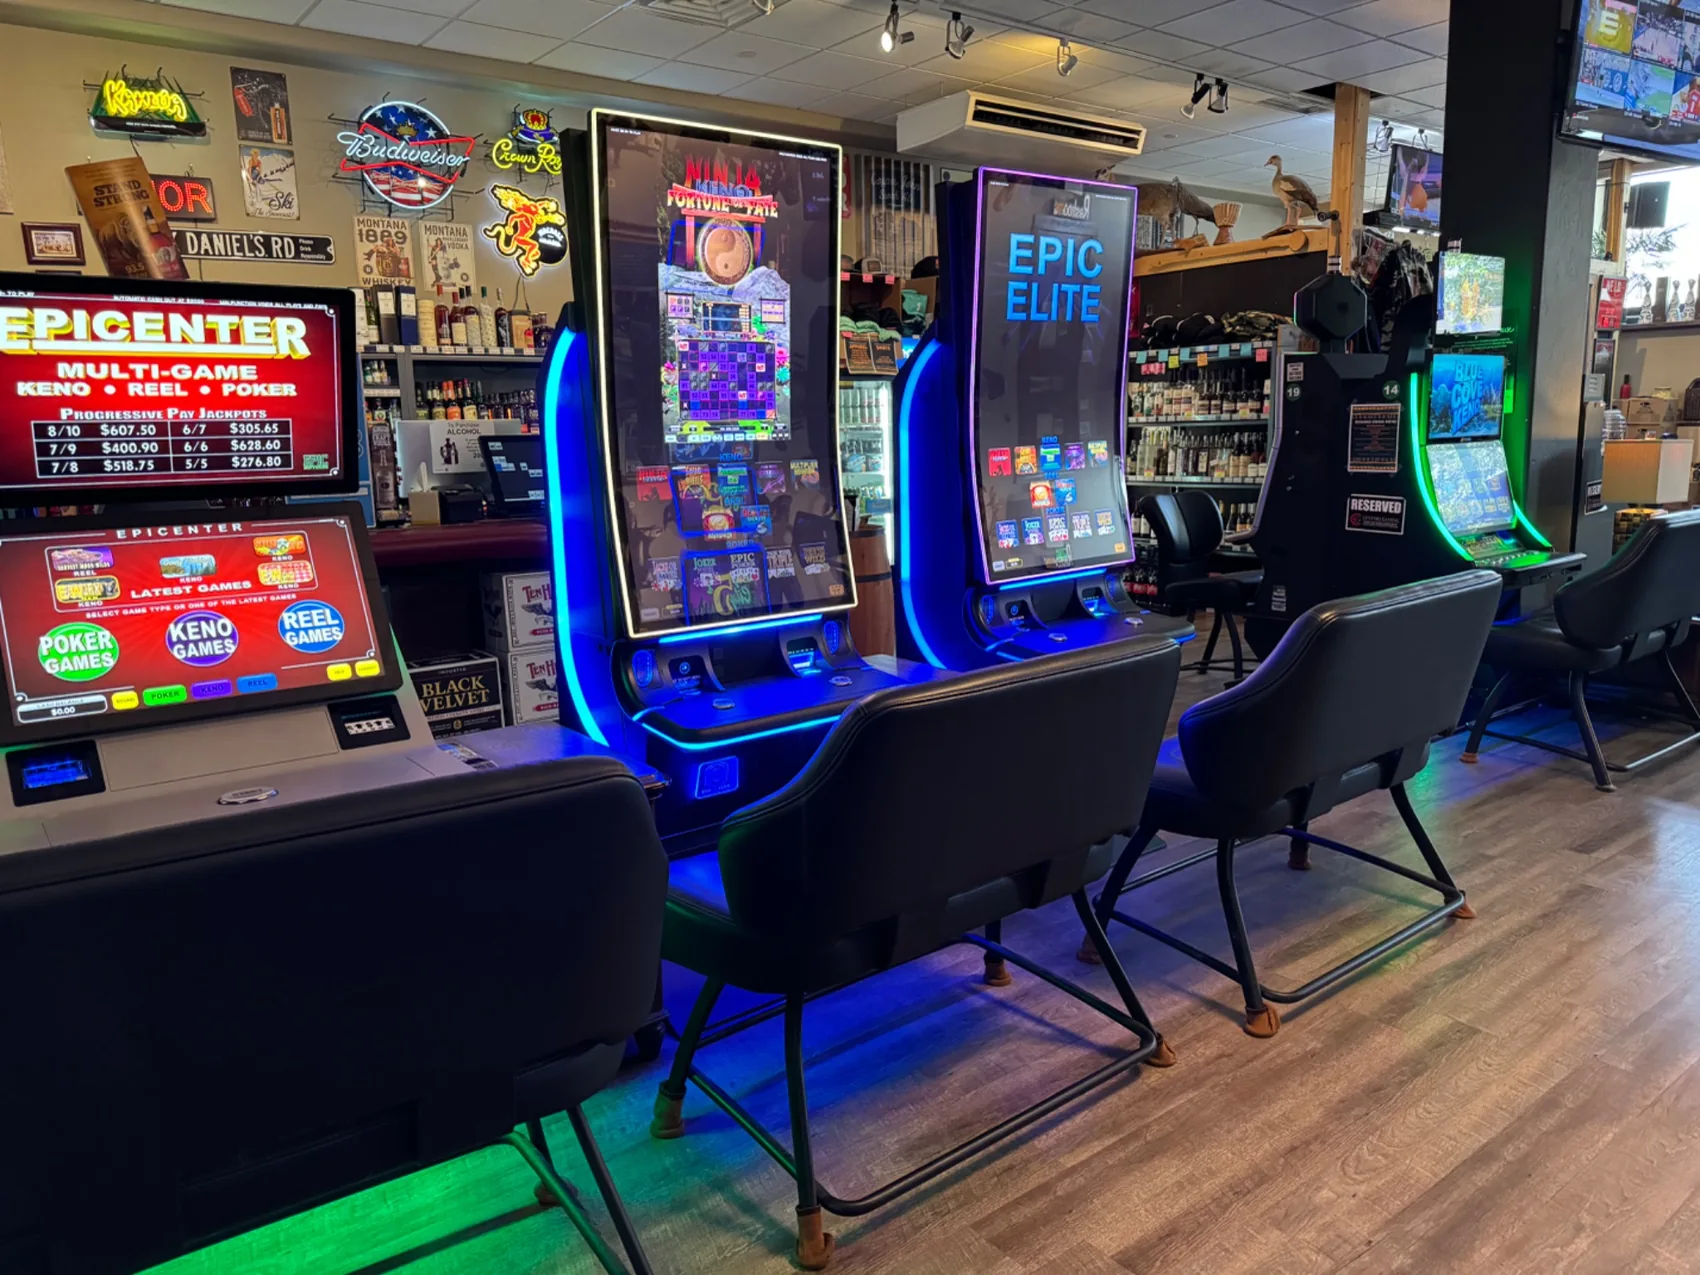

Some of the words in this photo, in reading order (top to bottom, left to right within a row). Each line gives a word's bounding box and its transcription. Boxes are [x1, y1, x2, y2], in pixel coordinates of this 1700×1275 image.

[337, 132, 470, 166] Budweiser
[493, 138, 537, 169] Crown
[525, 143, 562, 175] Roy
[684, 156, 762, 196] NINJA
[151, 180, 213, 213] OR
[269, 191, 294, 210] Ski
[667, 189, 730, 212] FORTUNE
[356, 218, 408, 231] MONTANA
[424, 224, 468, 238] MONTANA
[358, 228, 408, 245] 1889
[271, 236, 295, 259] RD
[1008, 232, 1103, 278] EPIC
[1006, 280, 1102, 322] ELITE
[0, 306, 311, 359] EPICENTER
[57, 362, 258, 381] MULTI-GAME
[1454, 363, 1483, 382] BLUE
[16, 382, 91, 396] KENO
[128, 382, 188, 396] REEL
[222, 383, 297, 396] POKER
[1287, 388, 1300, 397] 19
[1383, 385, 1399, 395] 14
[1451, 380, 1483, 409] COVE
[47, 425, 81, 437] 8/10
[100, 424, 156, 437] $607.50
[182, 424, 206, 435] 6/7
[230, 422, 279, 434] $305.65
[50, 444, 77, 456] 7/9
[102, 442, 158, 454] $400.90
[184, 441, 208, 452] 6/6
[231, 439, 281, 451] $628.60
[51, 462, 79, 474] 7/8
[103, 459, 155, 472] $518.75
[185, 458, 208, 469] 5/5
[231, 456, 282, 468] $276.80
[1350, 499, 1402, 514] RESERVED
[116, 523, 242, 539] EPICENTER
[730, 552, 755, 563] EPIC
[130, 586, 192, 599] LATEST
[198, 581, 252, 593] GAMES
[86, 610, 120, 619] SELECT
[122, 607, 147, 615] GAME
[238, 596, 267, 604] LATEST
[270, 593, 296, 601] GAMES
[282, 608, 339, 630] REEL
[168, 618, 232, 642] KENO
[285, 627, 343, 646] GAMES
[39, 630, 113, 655] POKER
[172, 638, 236, 660] GAMES
[45, 652, 114, 674] GAMES
[201, 685, 225, 693] KENO
[248, 679, 268, 687] REEL
[422, 675, 486, 697] BLACK
[151, 690, 180, 700] POKER
[420, 688, 490, 712] VELVET
[50, 706, 75, 716] $0.00
